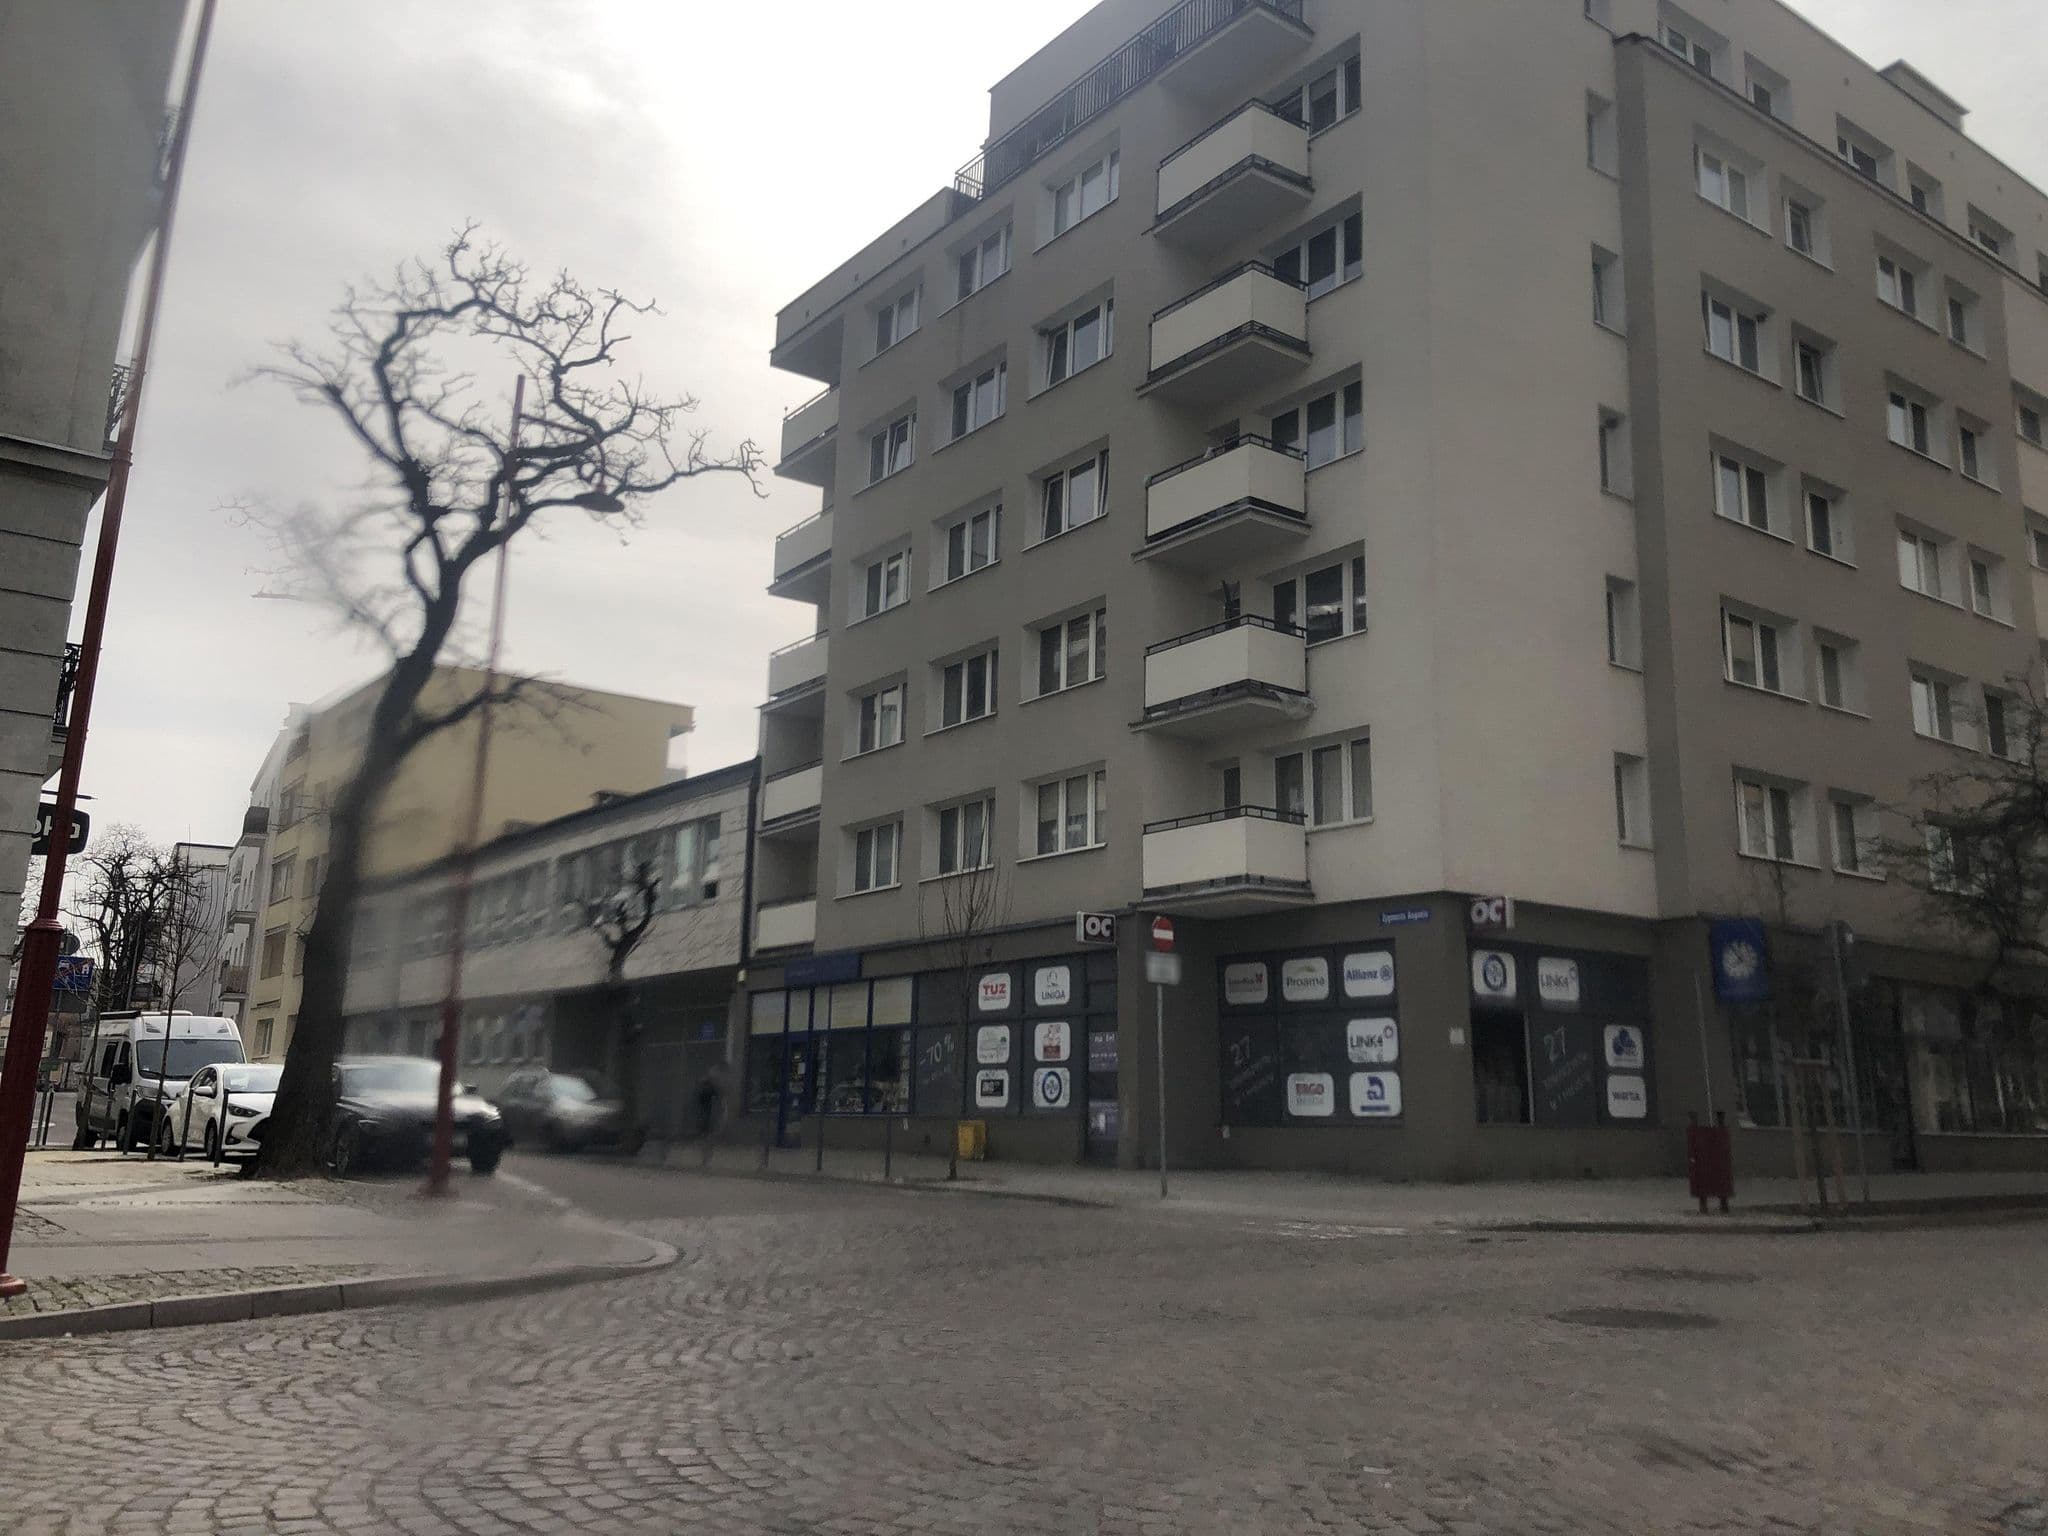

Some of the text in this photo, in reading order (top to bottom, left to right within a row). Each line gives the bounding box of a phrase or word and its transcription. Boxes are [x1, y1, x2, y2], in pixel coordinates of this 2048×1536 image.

[1472, 899, 1503, 923] OC
[1085, 917, 1112, 937] OC
[1347, 969, 1377, 984] Allianz
[983, 983, 1006, 995] TUZ
[1042, 990, 1066, 1000] UNIQA
[1350, 1035, 1383, 1049] LINK4
